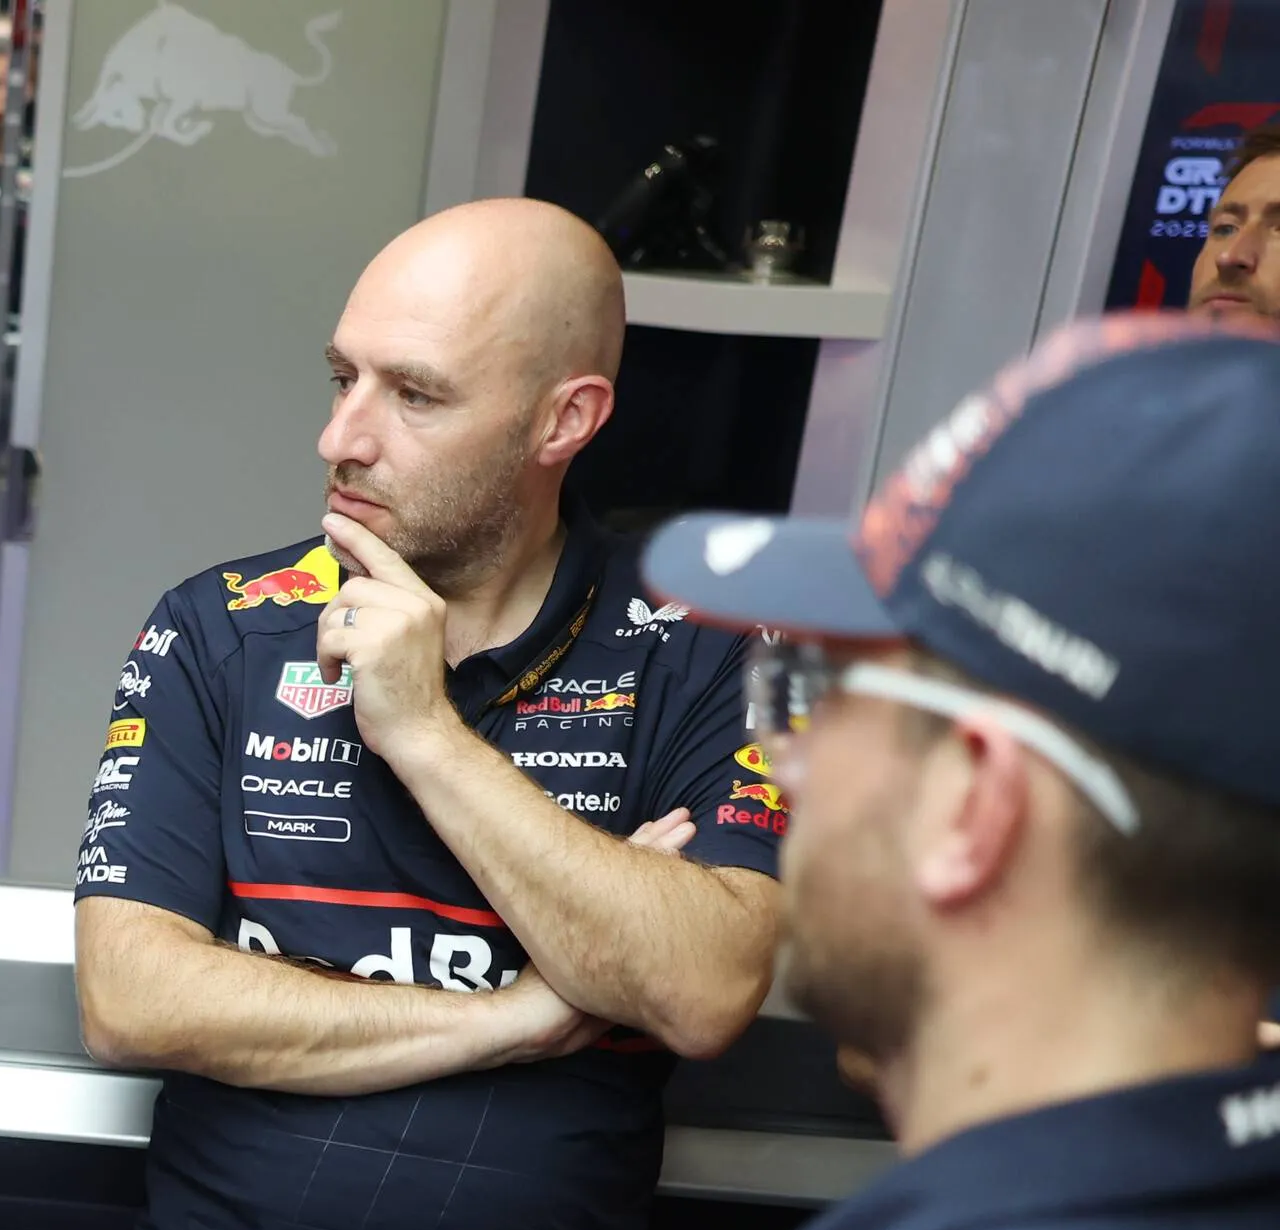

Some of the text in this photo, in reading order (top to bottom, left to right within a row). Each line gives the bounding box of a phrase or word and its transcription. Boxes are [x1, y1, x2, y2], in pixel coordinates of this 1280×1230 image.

[134, 624, 179, 657] bil
[281, 687, 350, 714] HEUER
[516, 696, 581, 715] Red Bull
[515, 717, 634, 732] RACING
[245, 731, 329, 763] Mobil
[511, 751, 627, 769] HONDA
[94, 756, 140, 788] RC
[241, 774, 353, 799] ORACLE
[544, 790, 621, 812] ate.io
[267, 820, 317, 834] MARK
[77, 865, 128, 885] ADE
